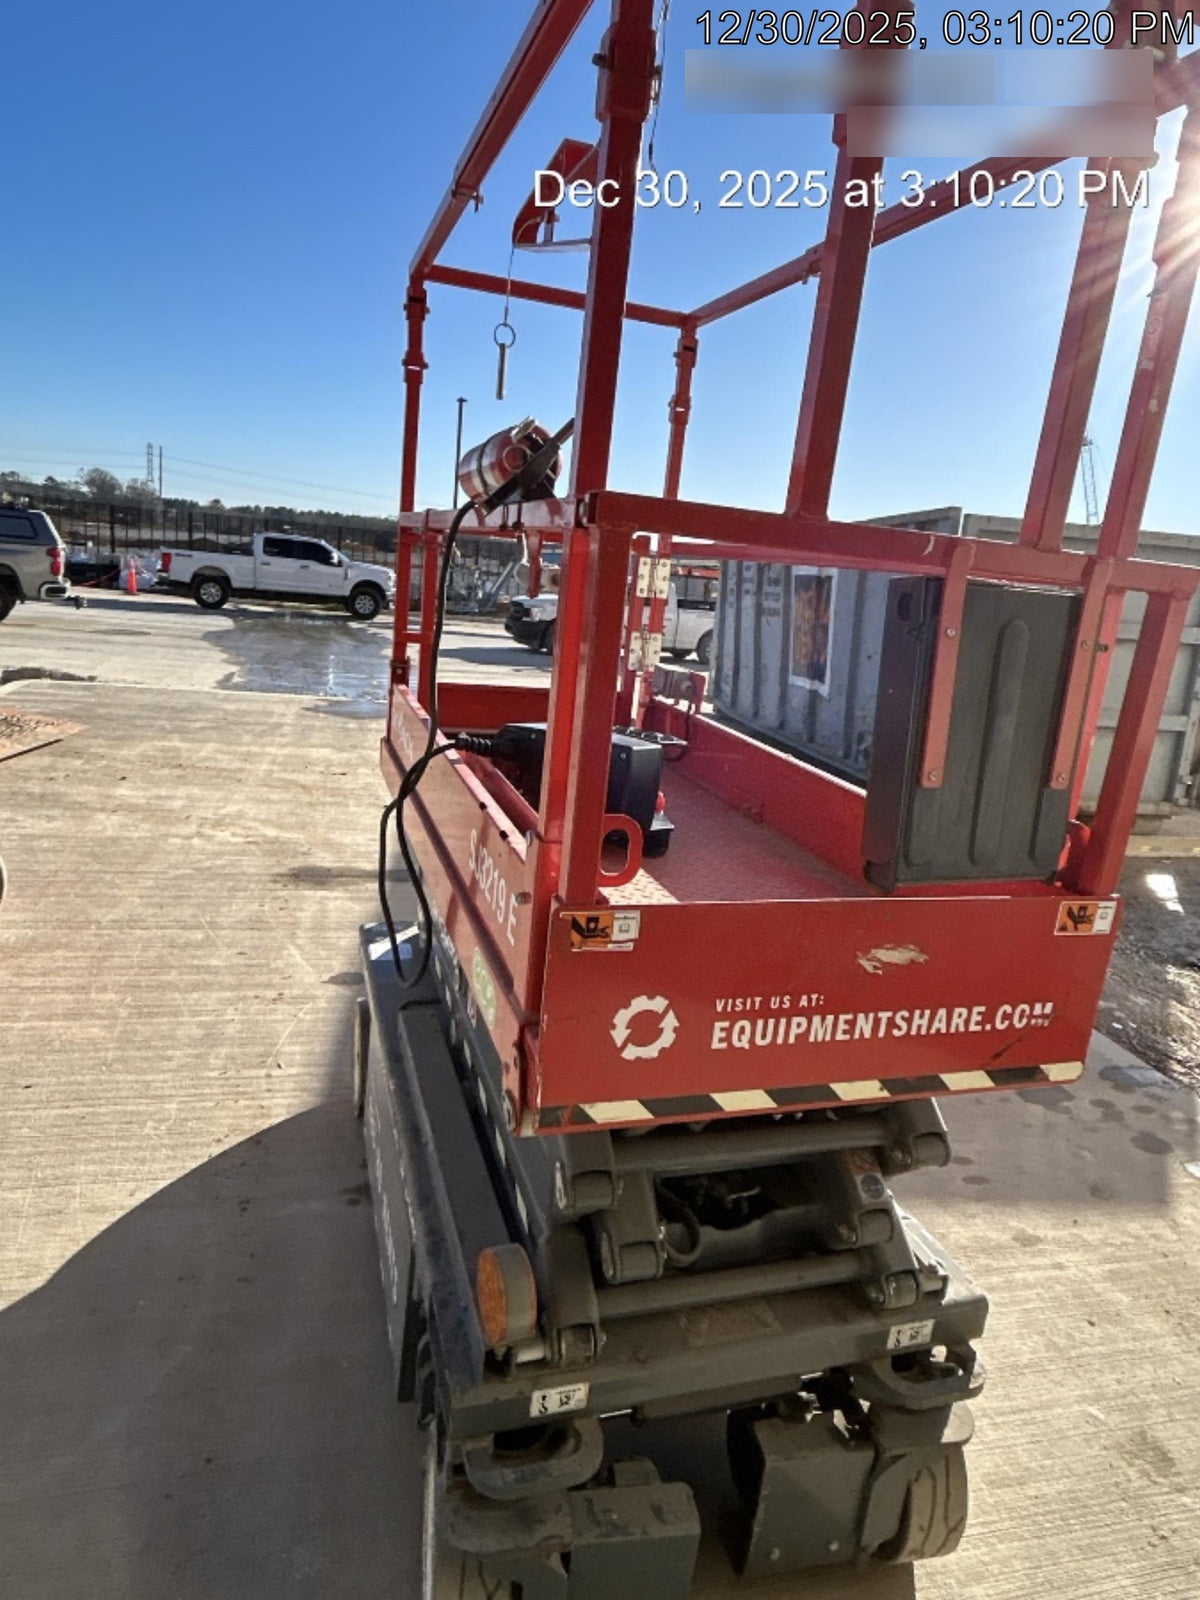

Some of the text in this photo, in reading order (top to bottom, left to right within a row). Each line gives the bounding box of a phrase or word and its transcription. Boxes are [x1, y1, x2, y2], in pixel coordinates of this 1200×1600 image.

[715, 993, 825, 1012] VISIT US AT:
[711, 1001, 1054, 1050] EQUIPMENTSHARE.COM
